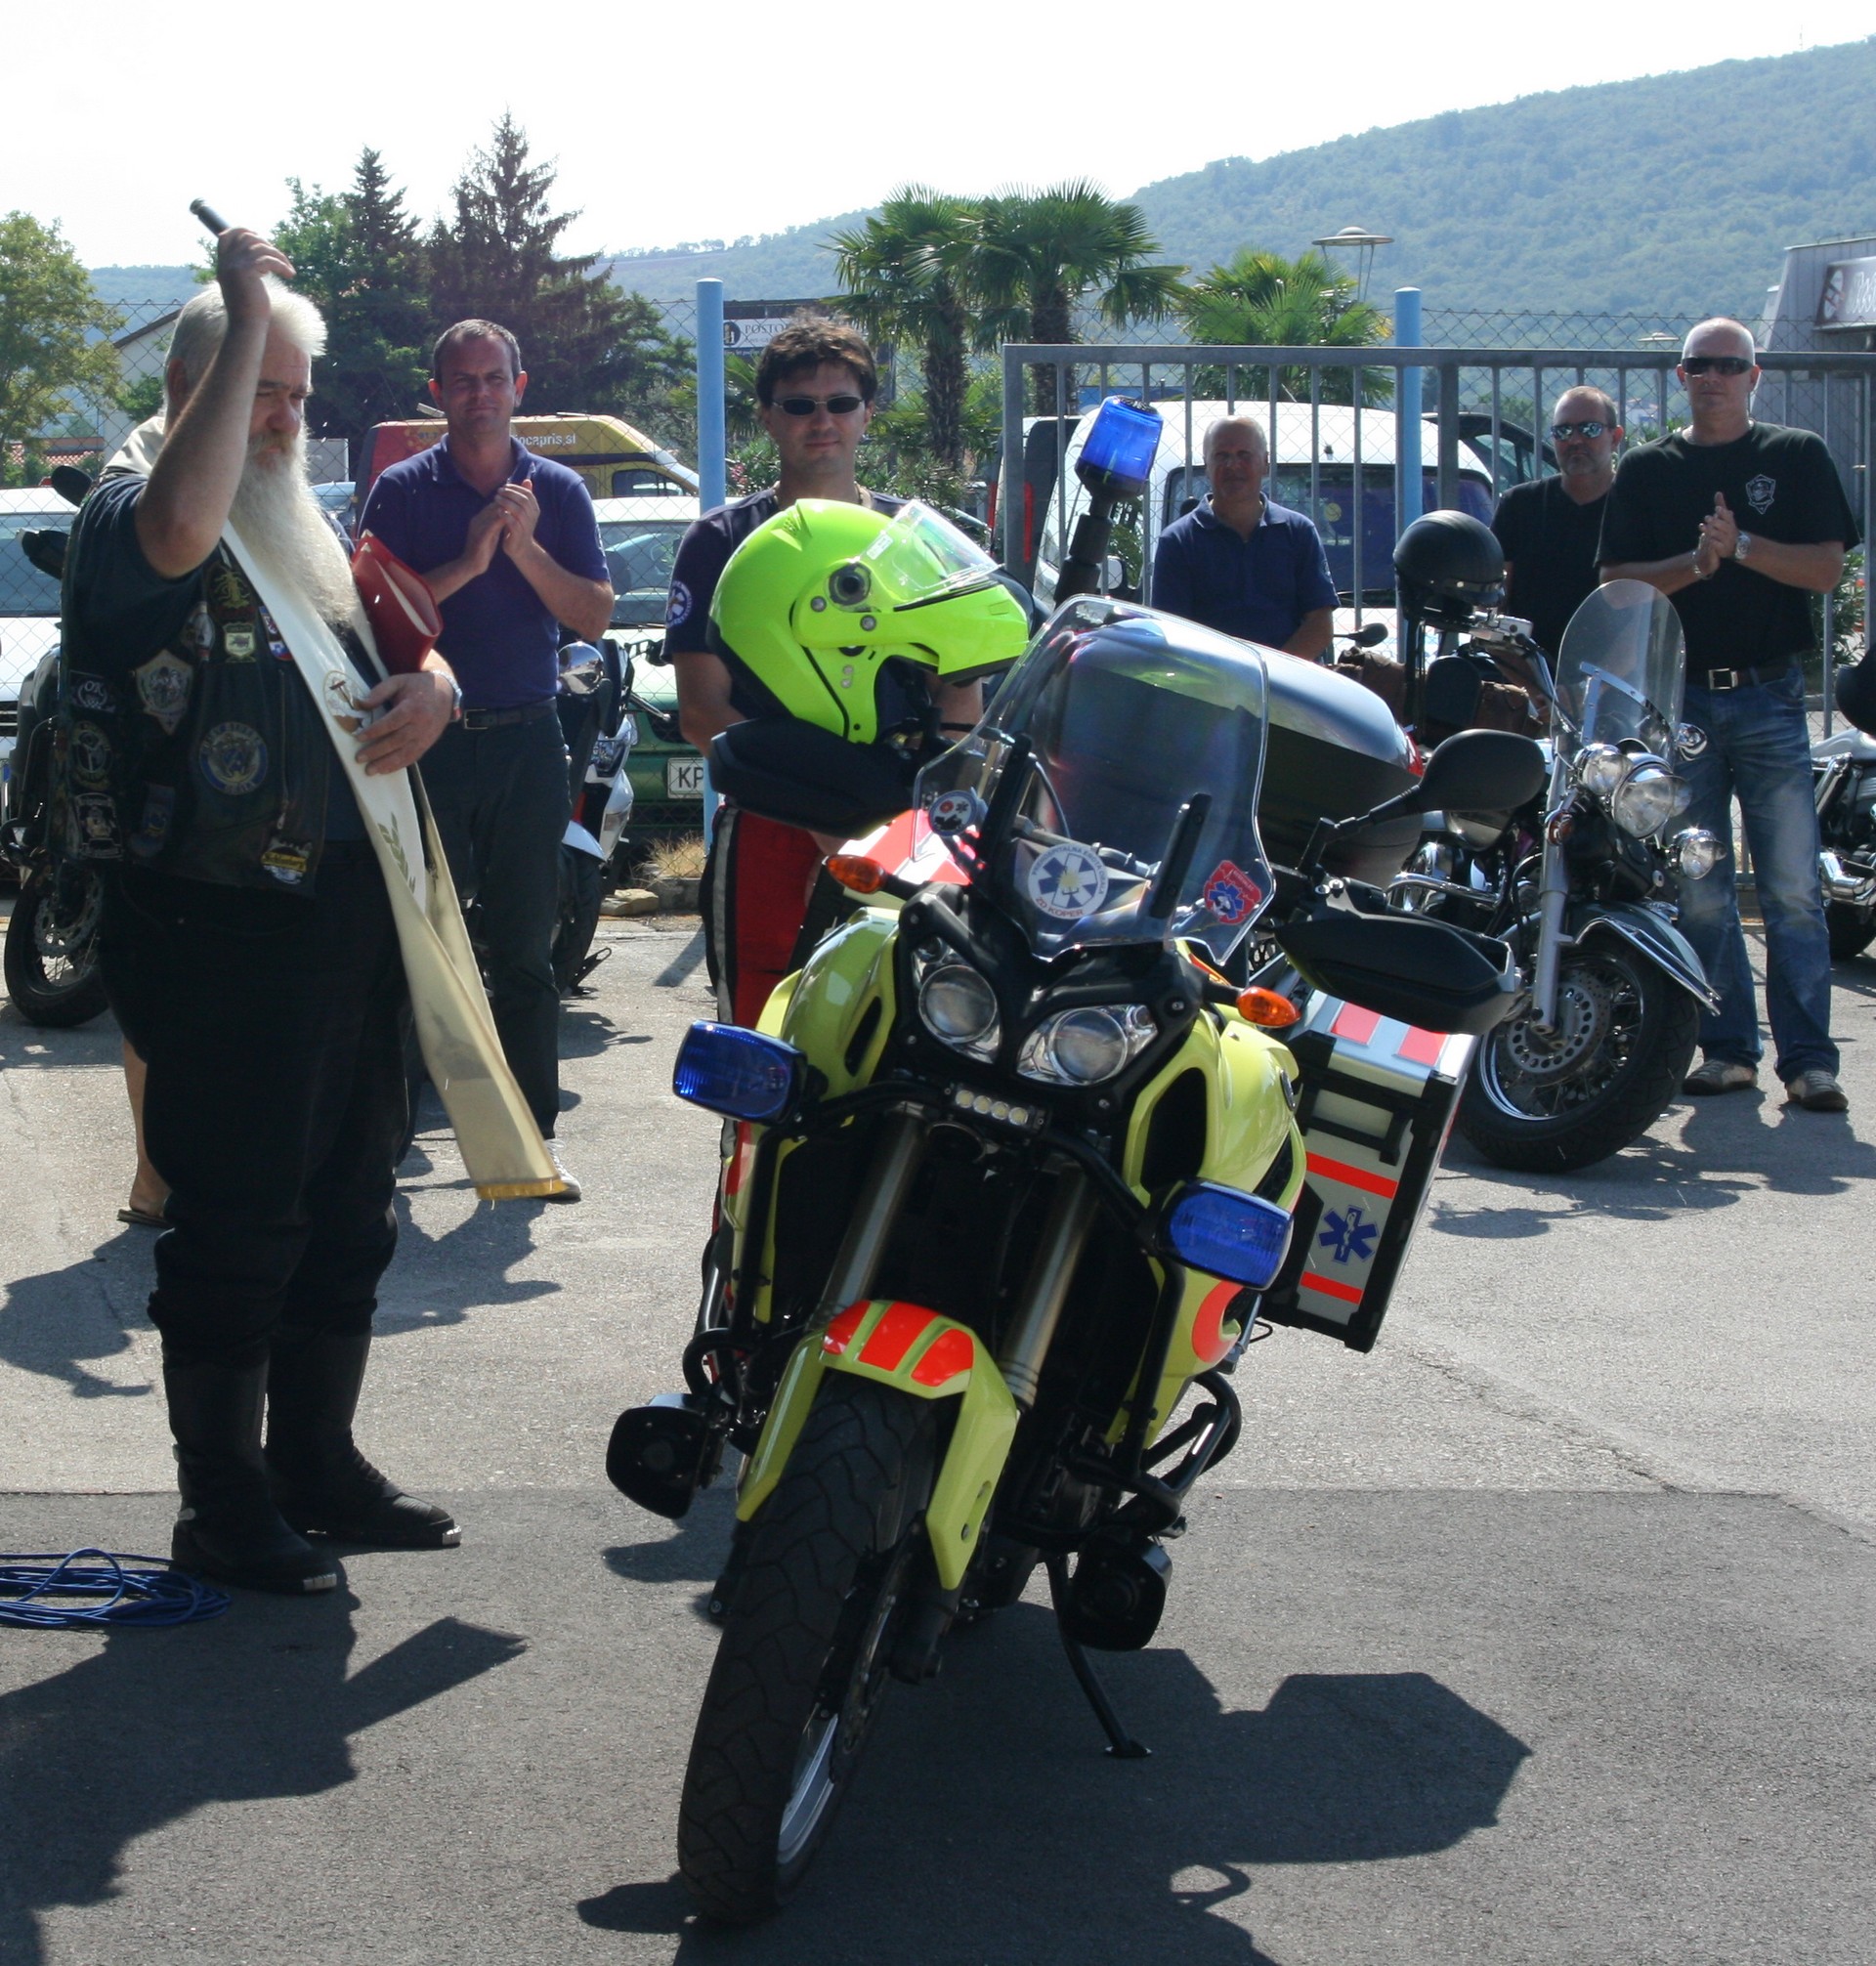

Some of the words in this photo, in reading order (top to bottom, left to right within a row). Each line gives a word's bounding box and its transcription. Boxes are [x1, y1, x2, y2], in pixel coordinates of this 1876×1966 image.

[678, 766, 704, 789] KP
[1035, 896, 1047, 909] ZD
[1048, 906, 1084, 918] KOPER
